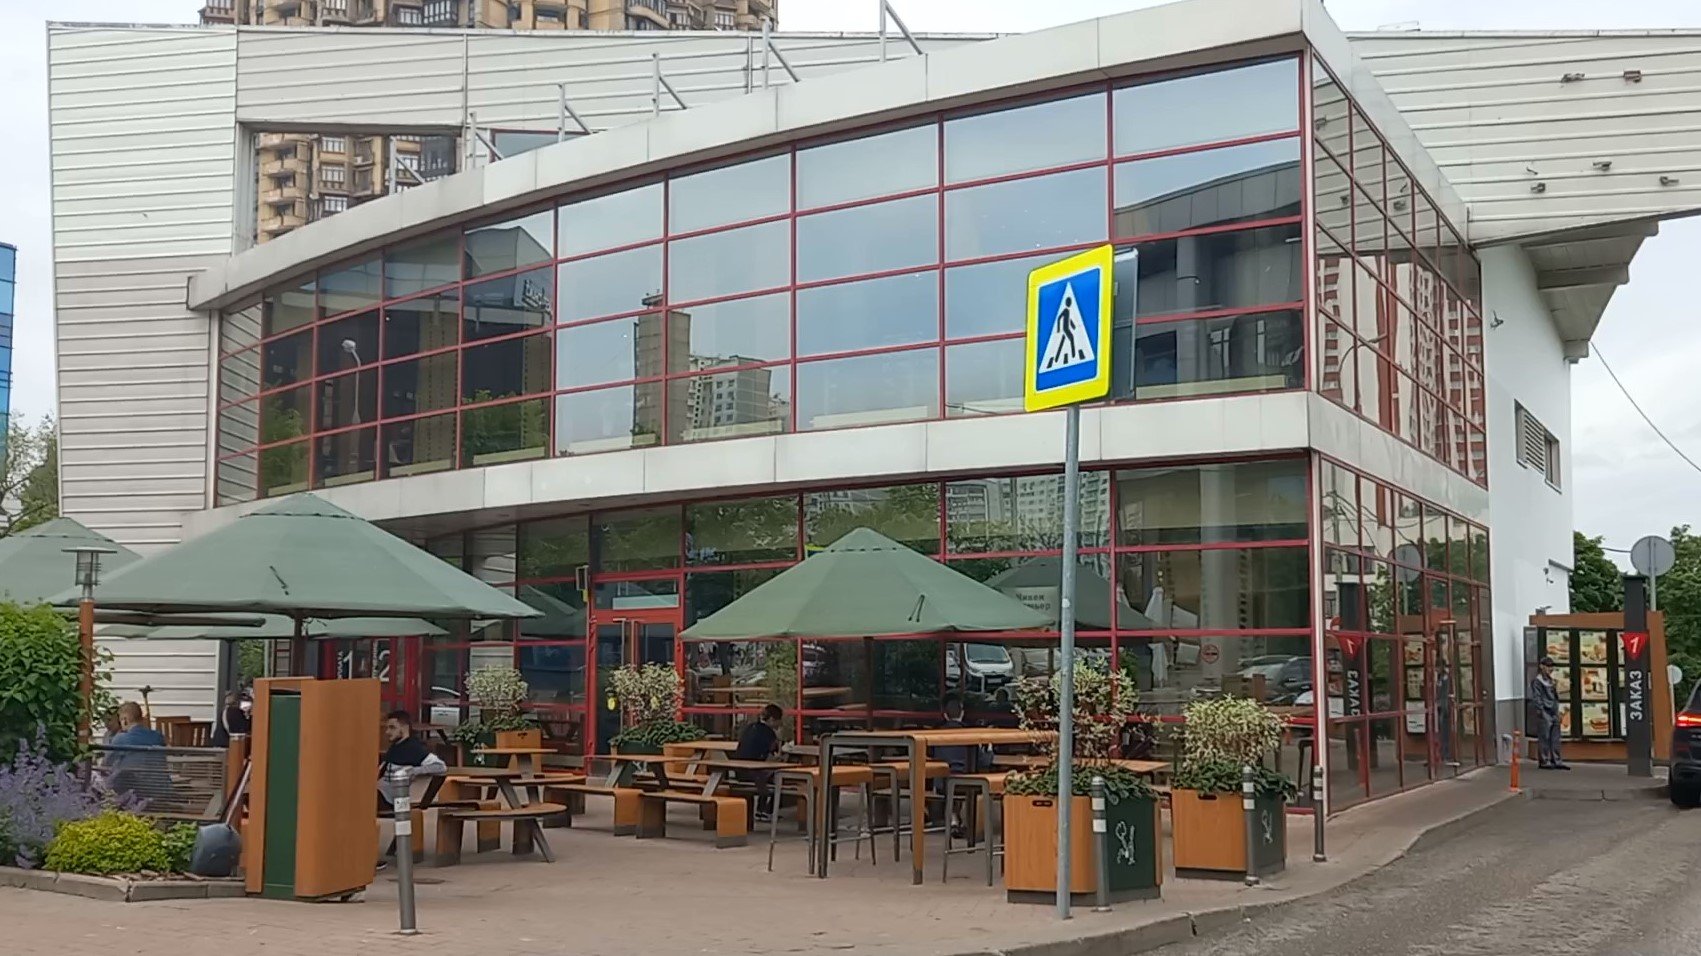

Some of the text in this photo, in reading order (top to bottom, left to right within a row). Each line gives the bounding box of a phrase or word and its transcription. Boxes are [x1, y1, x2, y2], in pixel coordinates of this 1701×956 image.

[1630, 636, 1640, 654] 1
[343, 650, 353, 680] 1
[379, 649, 391, 682] 2
[1629, 670, 1643, 720] ЗАКАЗ
